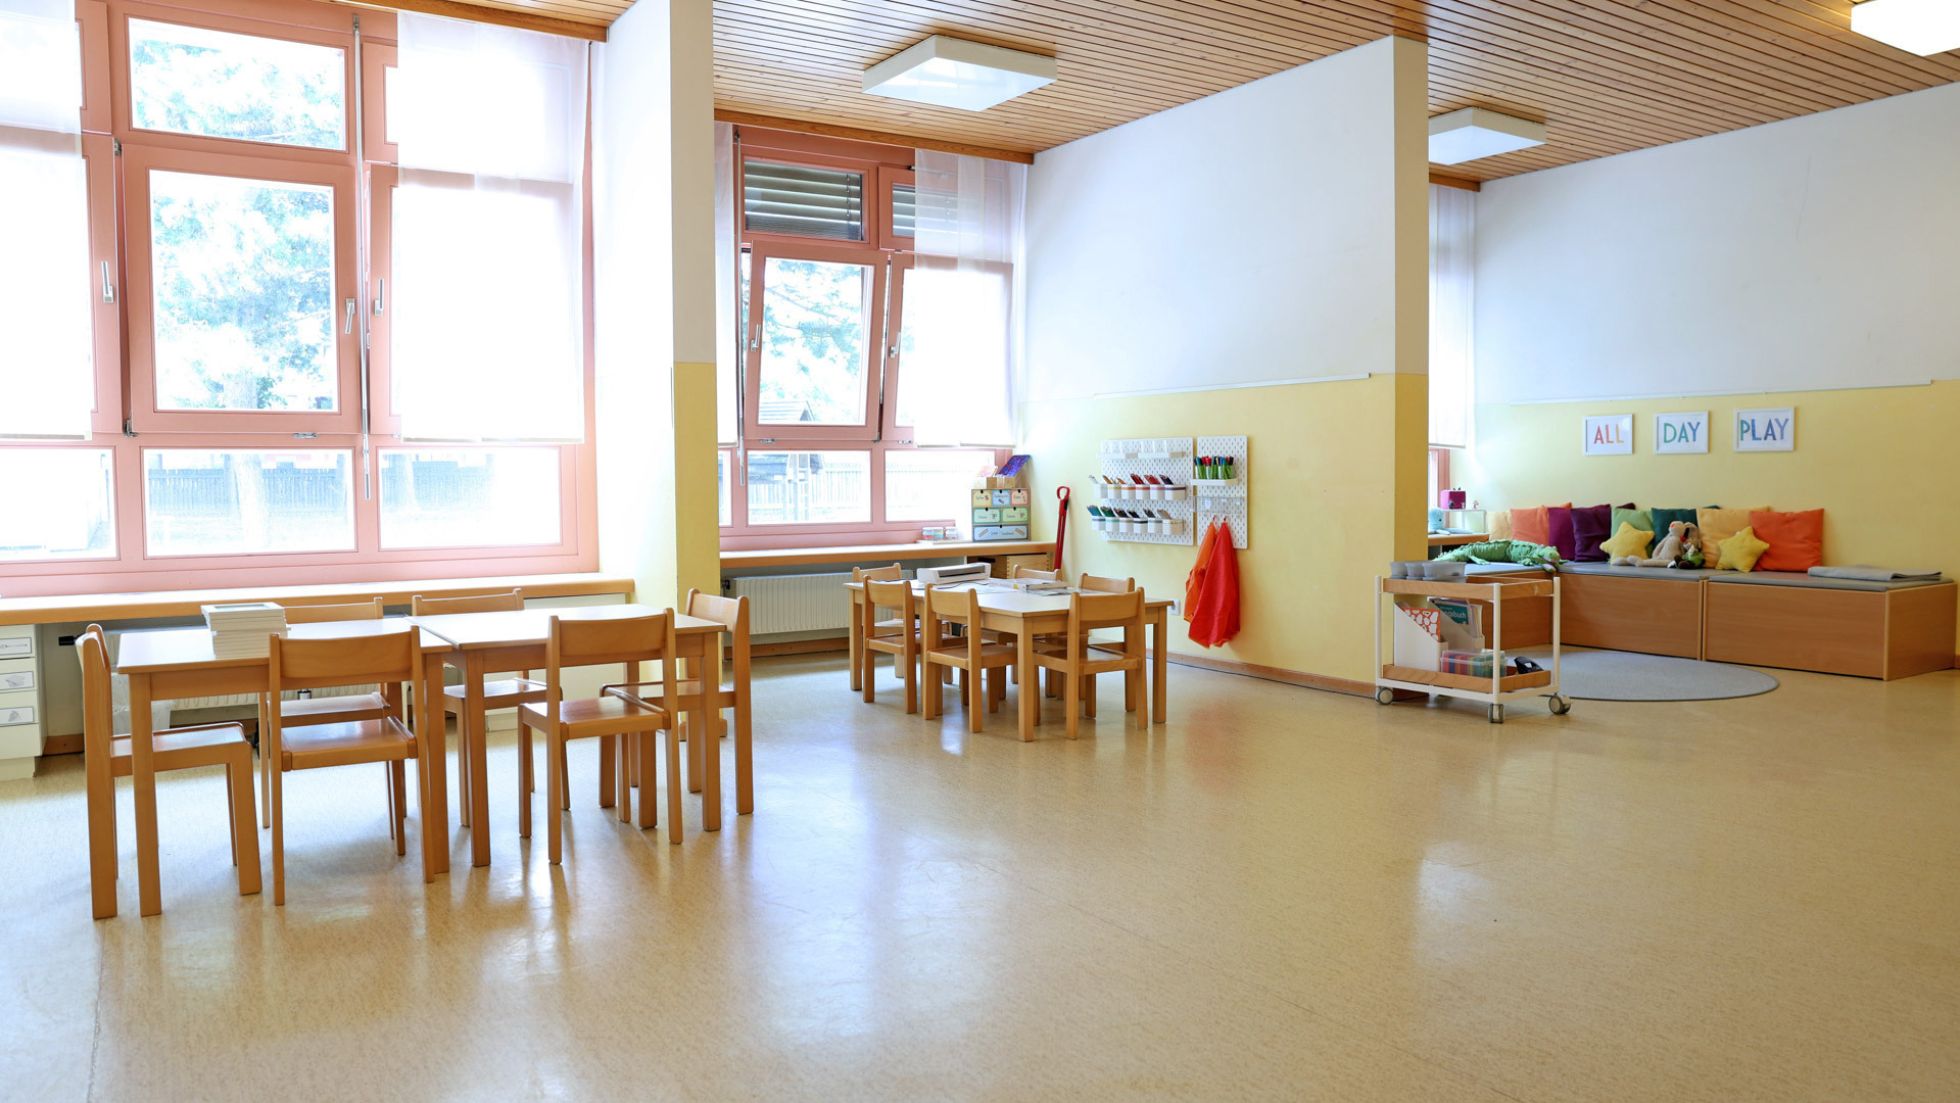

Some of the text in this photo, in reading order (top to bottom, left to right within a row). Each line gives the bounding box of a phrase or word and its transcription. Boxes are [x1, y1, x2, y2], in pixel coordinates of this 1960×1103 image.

[1593, 419, 1789, 444] ALL DAY PLAY
